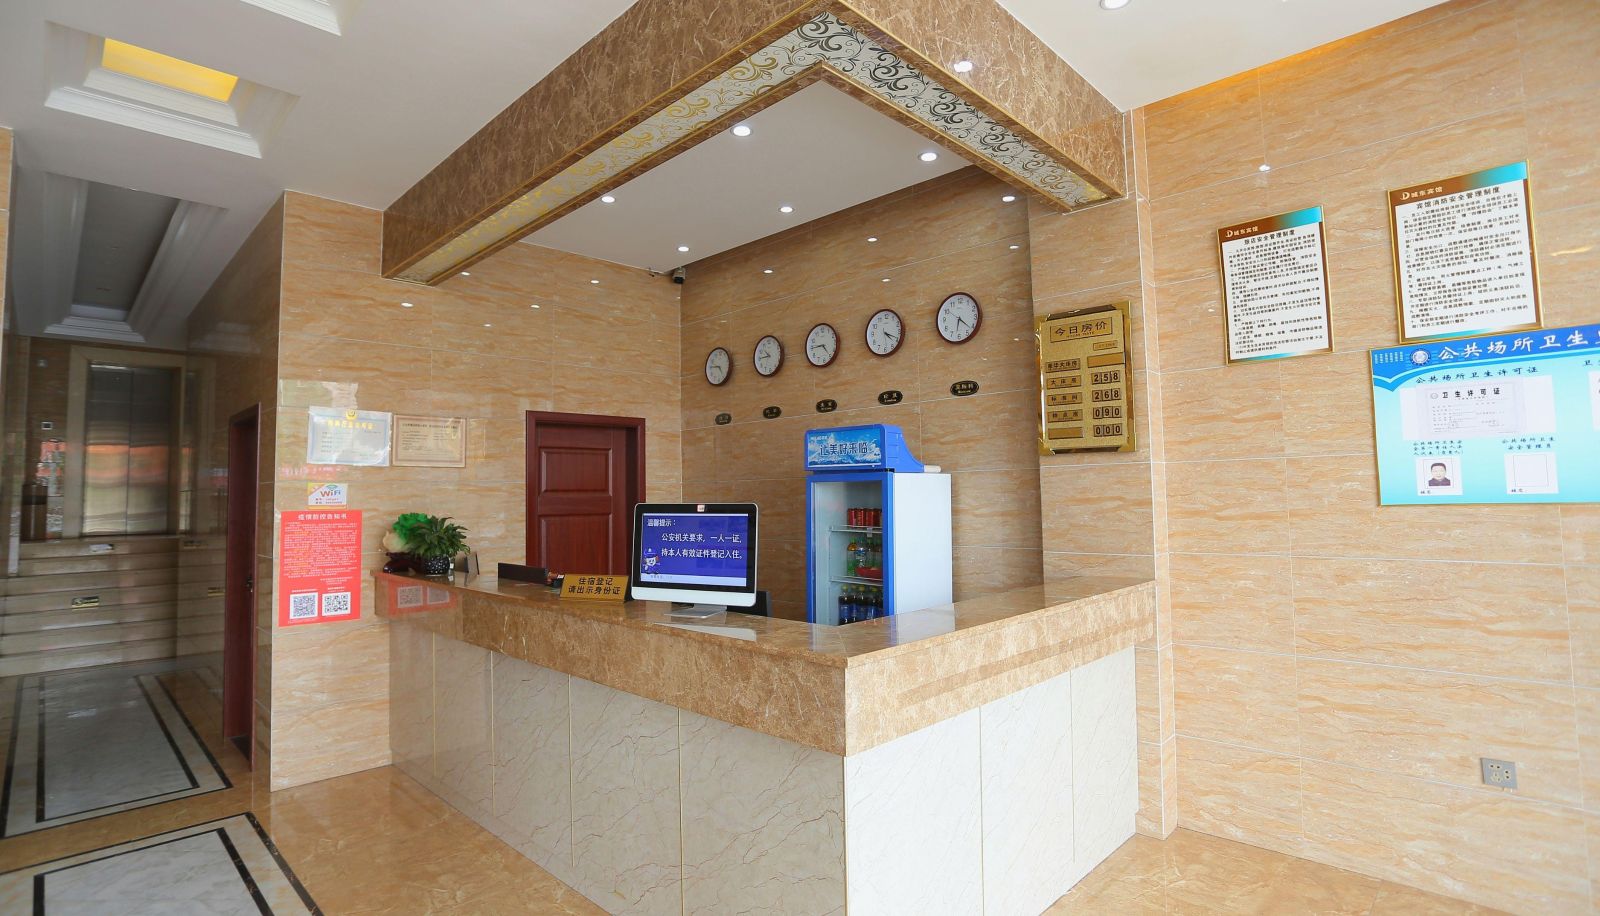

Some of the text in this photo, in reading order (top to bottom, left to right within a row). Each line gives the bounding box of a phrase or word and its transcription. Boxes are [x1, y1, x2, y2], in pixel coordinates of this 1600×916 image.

[1416, 186, 1500, 210] 宾馆消防安全管理制度
[1056, 321, 1106, 336] 今日房价
[1094, 372, 1118, 382] 258
[1416, 366, 1538, 383] 公共场所卫生许可证
[1094, 389, 1119, 400] 268
[1442, 387, 1500, 399] 卫生许可证
[1095, 407, 1120, 417] 090
[1095, 424, 1121, 435] 000
[578, 577, 613, 586] 住宿登记
[568, 585, 621, 595] 请出示身份证
